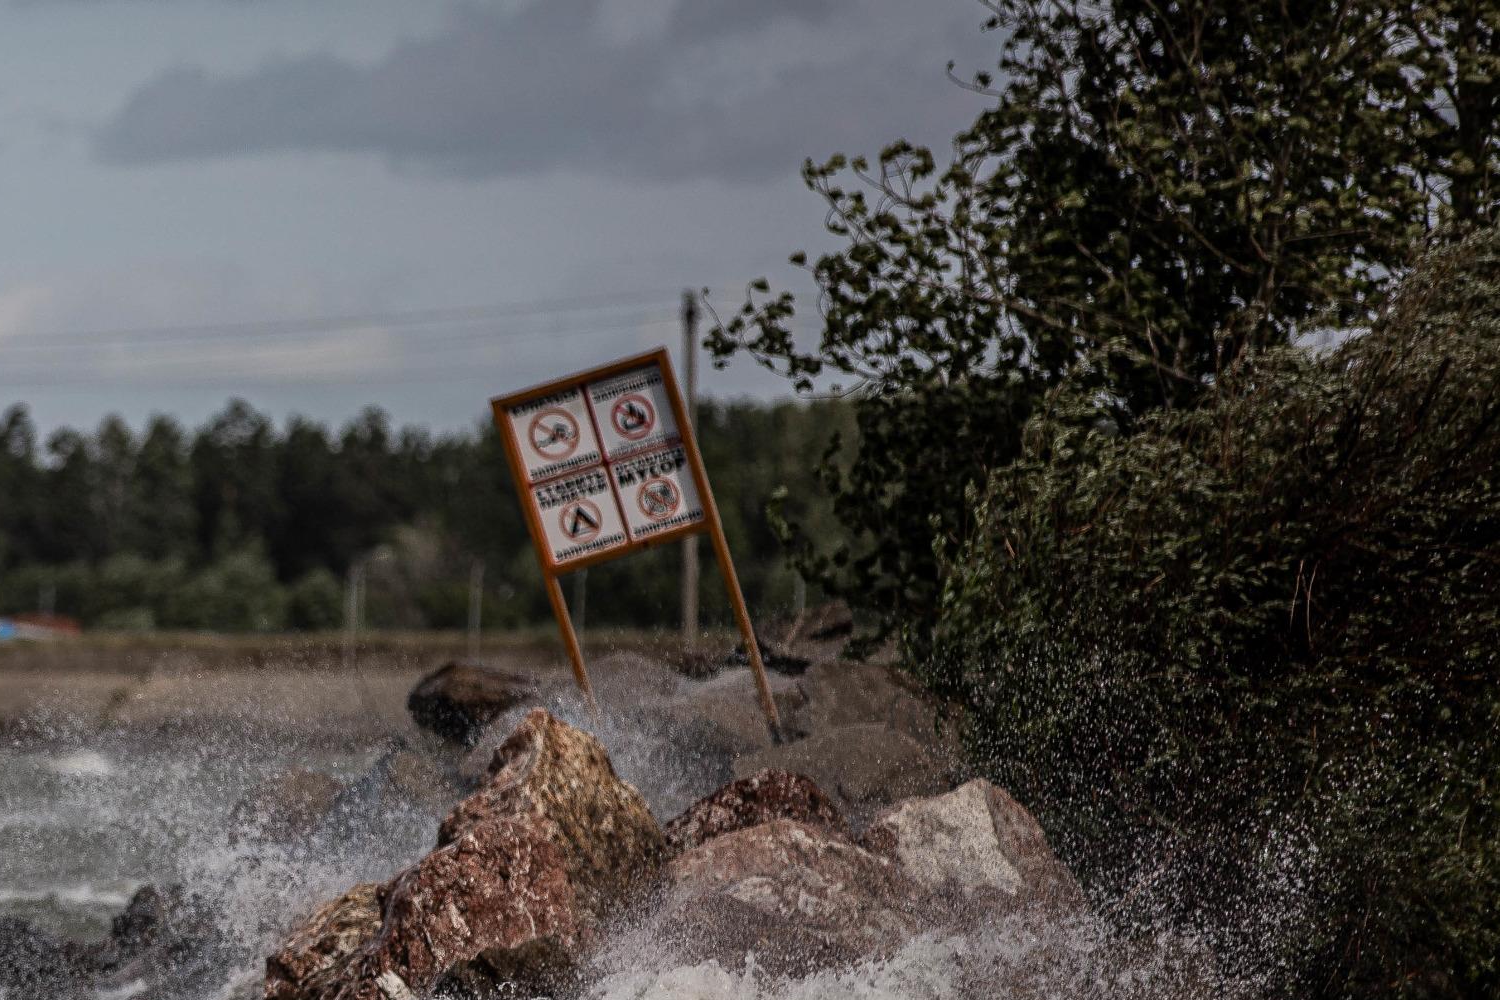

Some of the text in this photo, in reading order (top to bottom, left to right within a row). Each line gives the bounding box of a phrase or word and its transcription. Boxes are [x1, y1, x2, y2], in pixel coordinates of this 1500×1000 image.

[530, 451, 598, 478] ЗАПРЕЩЕНО
[618, 456, 687, 486] МУСОР
[535, 470, 603, 497] СТАВИТЬ
[632, 509, 702, 536] ЗАПРЕЩЕНО
[554, 533, 623, 560] ЗАПРЕЩЕНО
